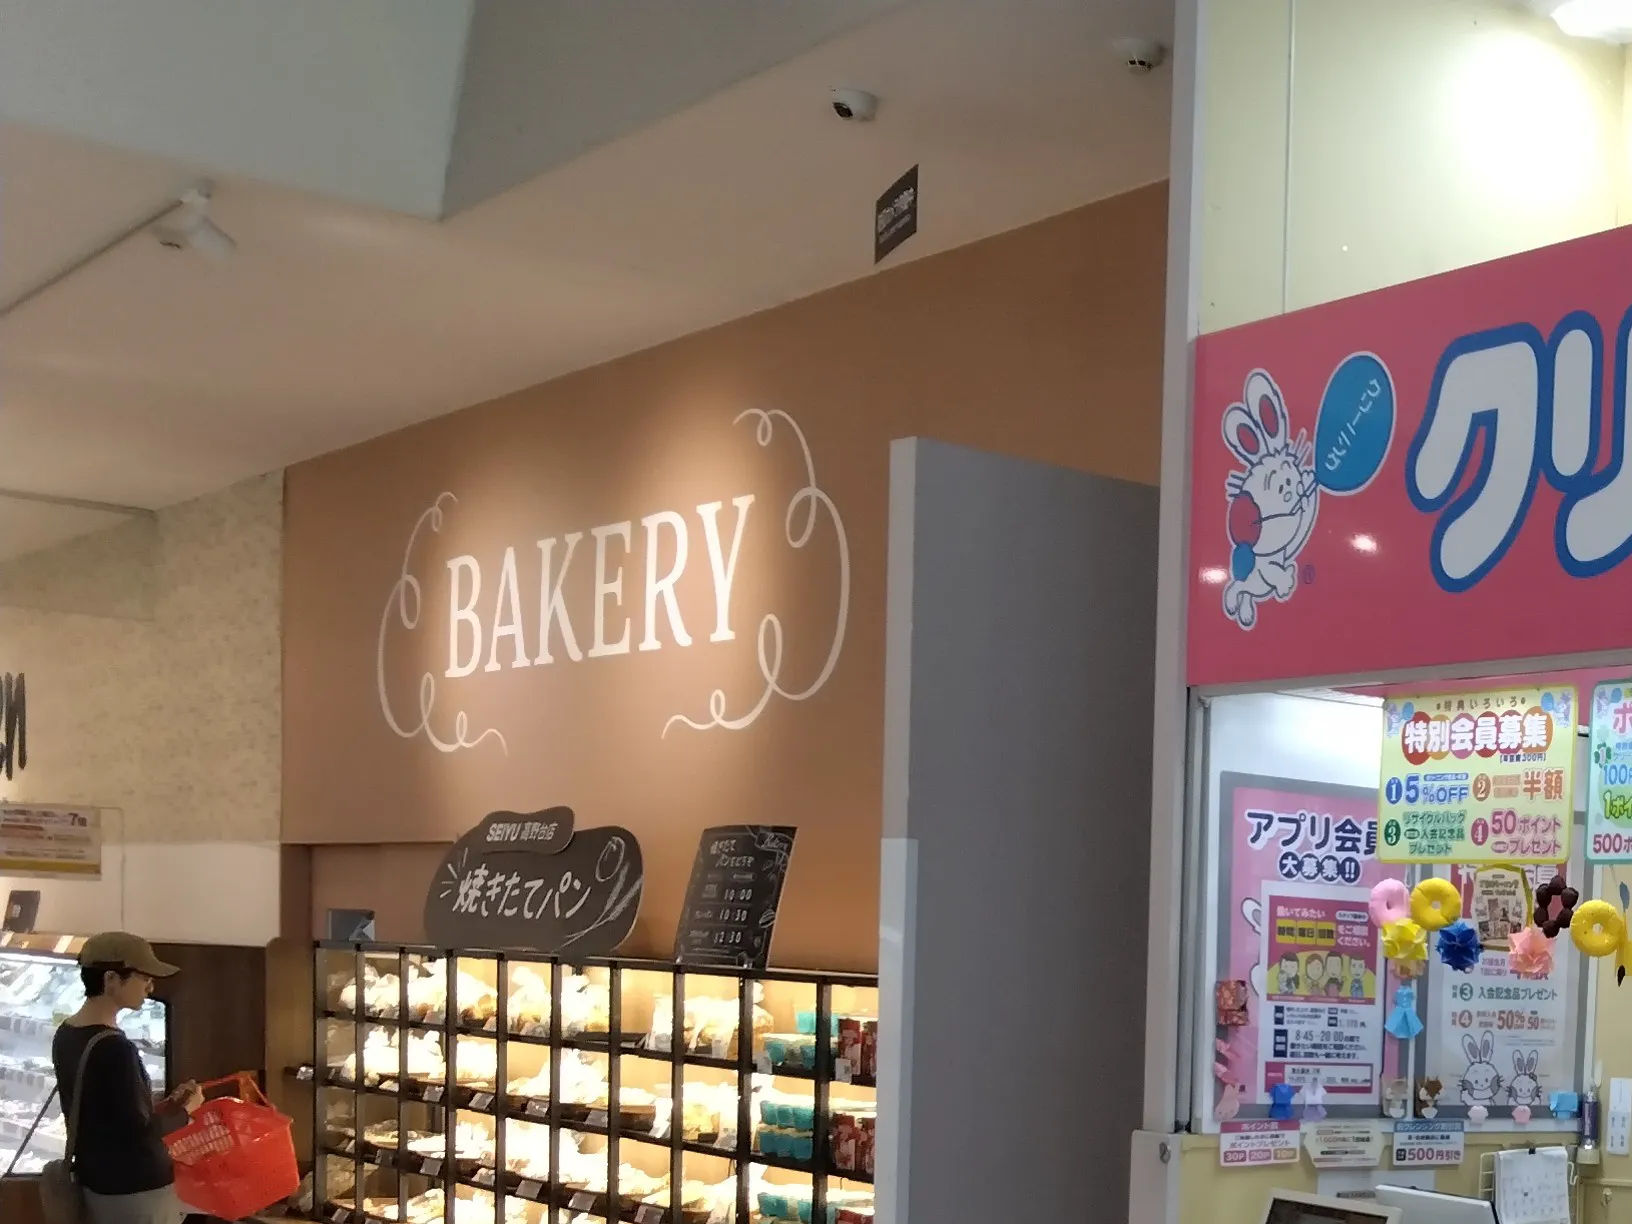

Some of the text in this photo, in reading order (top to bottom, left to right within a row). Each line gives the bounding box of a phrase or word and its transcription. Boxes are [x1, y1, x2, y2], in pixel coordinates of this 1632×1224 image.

[445, 494, 755, 678] BAKERY
[1405, 713, 1548, 753] 特別会員募集
[1523, 769, 1564, 800] 半額
[486, 823, 520, 841] SEIYU
[1492, 810, 1561, 834] 50ポイント
[1510, 841, 1561, 854] プレゼント
[453, 863, 591, 919] 焼きたてパン
